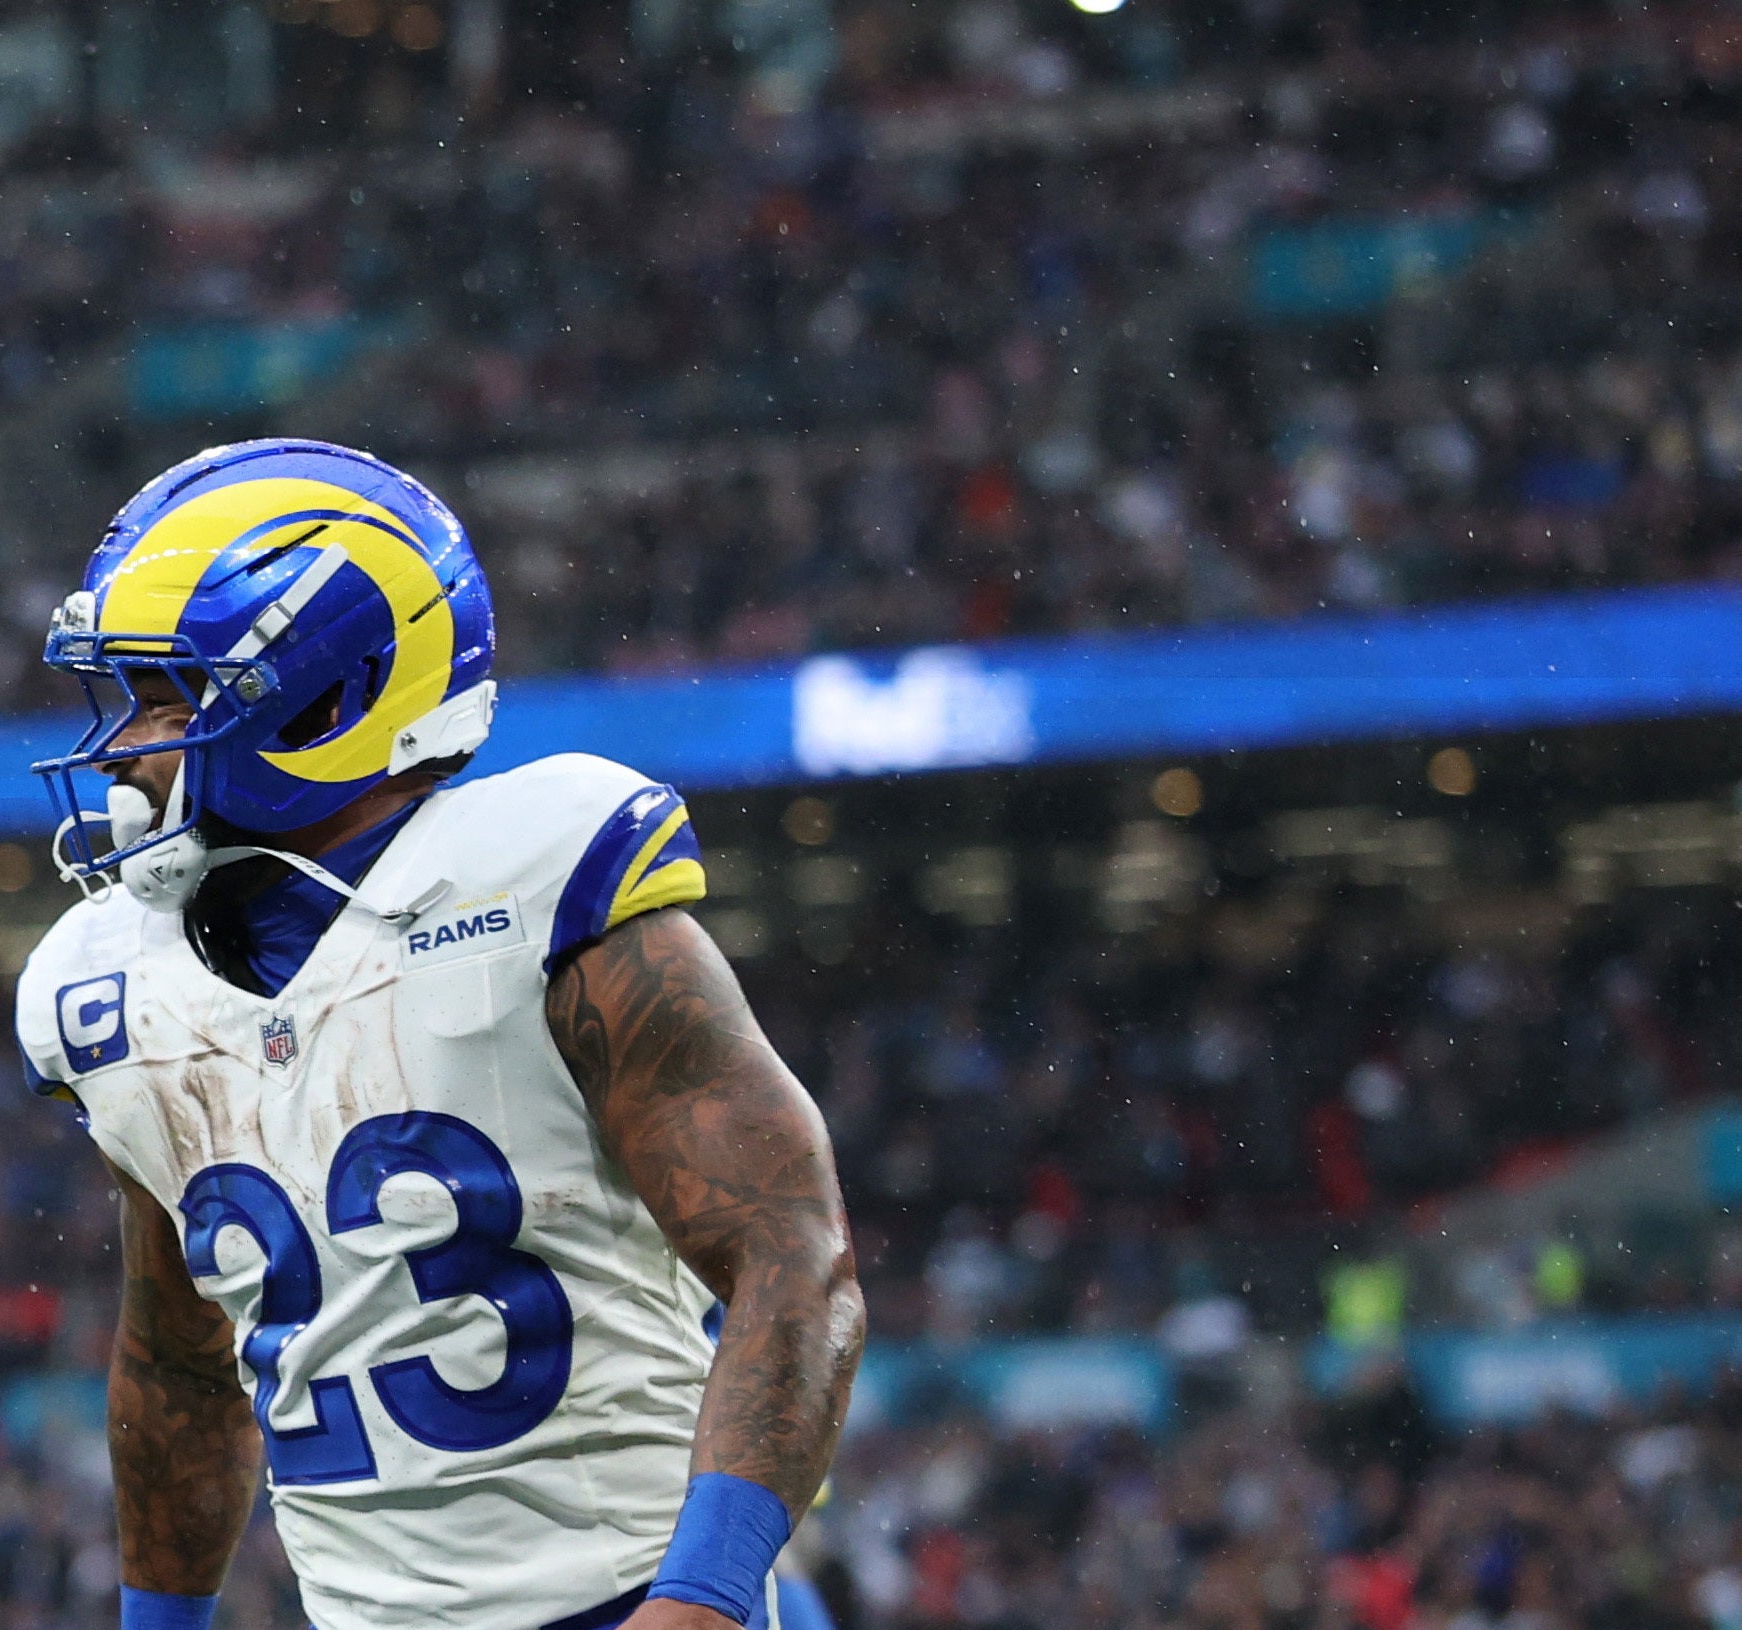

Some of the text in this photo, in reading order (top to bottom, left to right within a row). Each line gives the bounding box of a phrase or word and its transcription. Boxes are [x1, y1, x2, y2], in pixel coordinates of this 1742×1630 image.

[408, 909, 511, 955] RAMS
[61, 979, 120, 1049] C
[178, 1110, 574, 1485] 23
